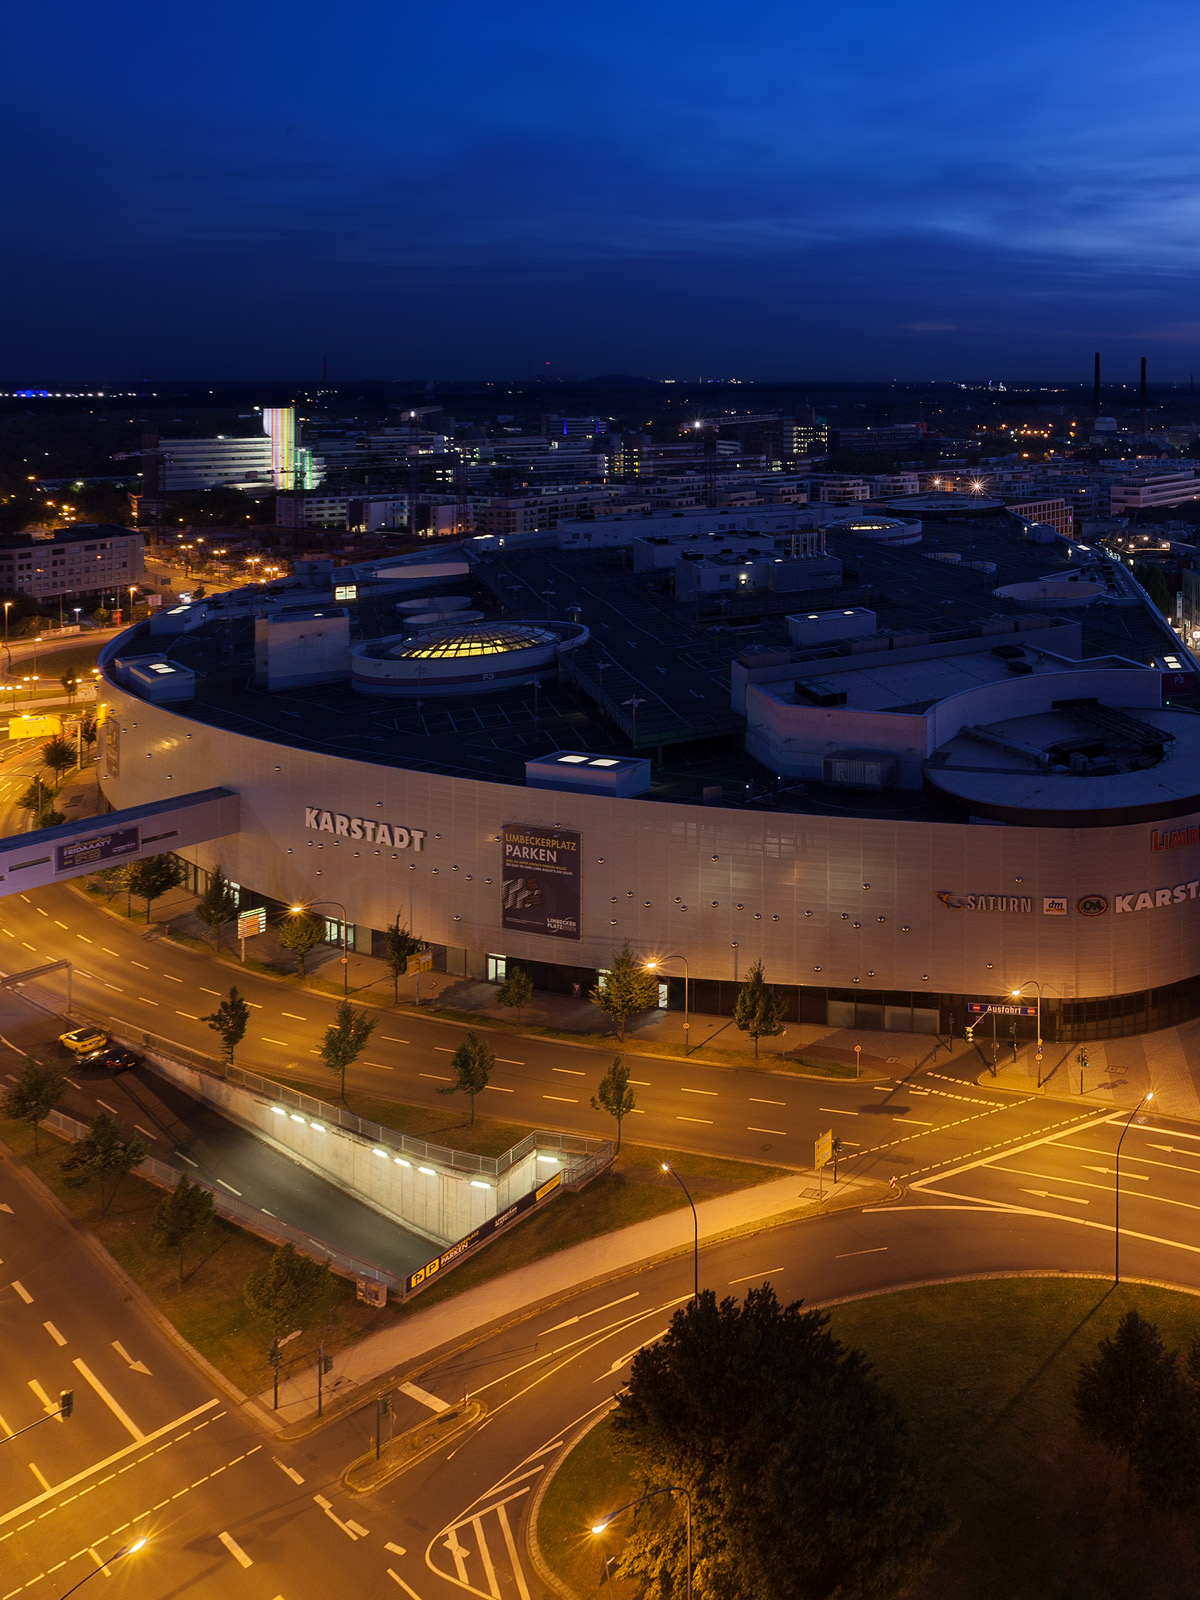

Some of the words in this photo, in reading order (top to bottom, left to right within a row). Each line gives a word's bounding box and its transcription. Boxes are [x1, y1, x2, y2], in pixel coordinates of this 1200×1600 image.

[482, 672, 495, 680] P3
[305, 806, 427, 852] KARSTADT
[505, 833, 577, 851] LIMBECKERPLATZ
[506, 844, 557, 863] PARKEN
[966, 893, 1032, 913] SATURN
[1047, 899, 1064, 910] dm
[987, 1005, 1021, 1014] Ausfahrt
[440, 1242, 469, 1265] PARKEN
